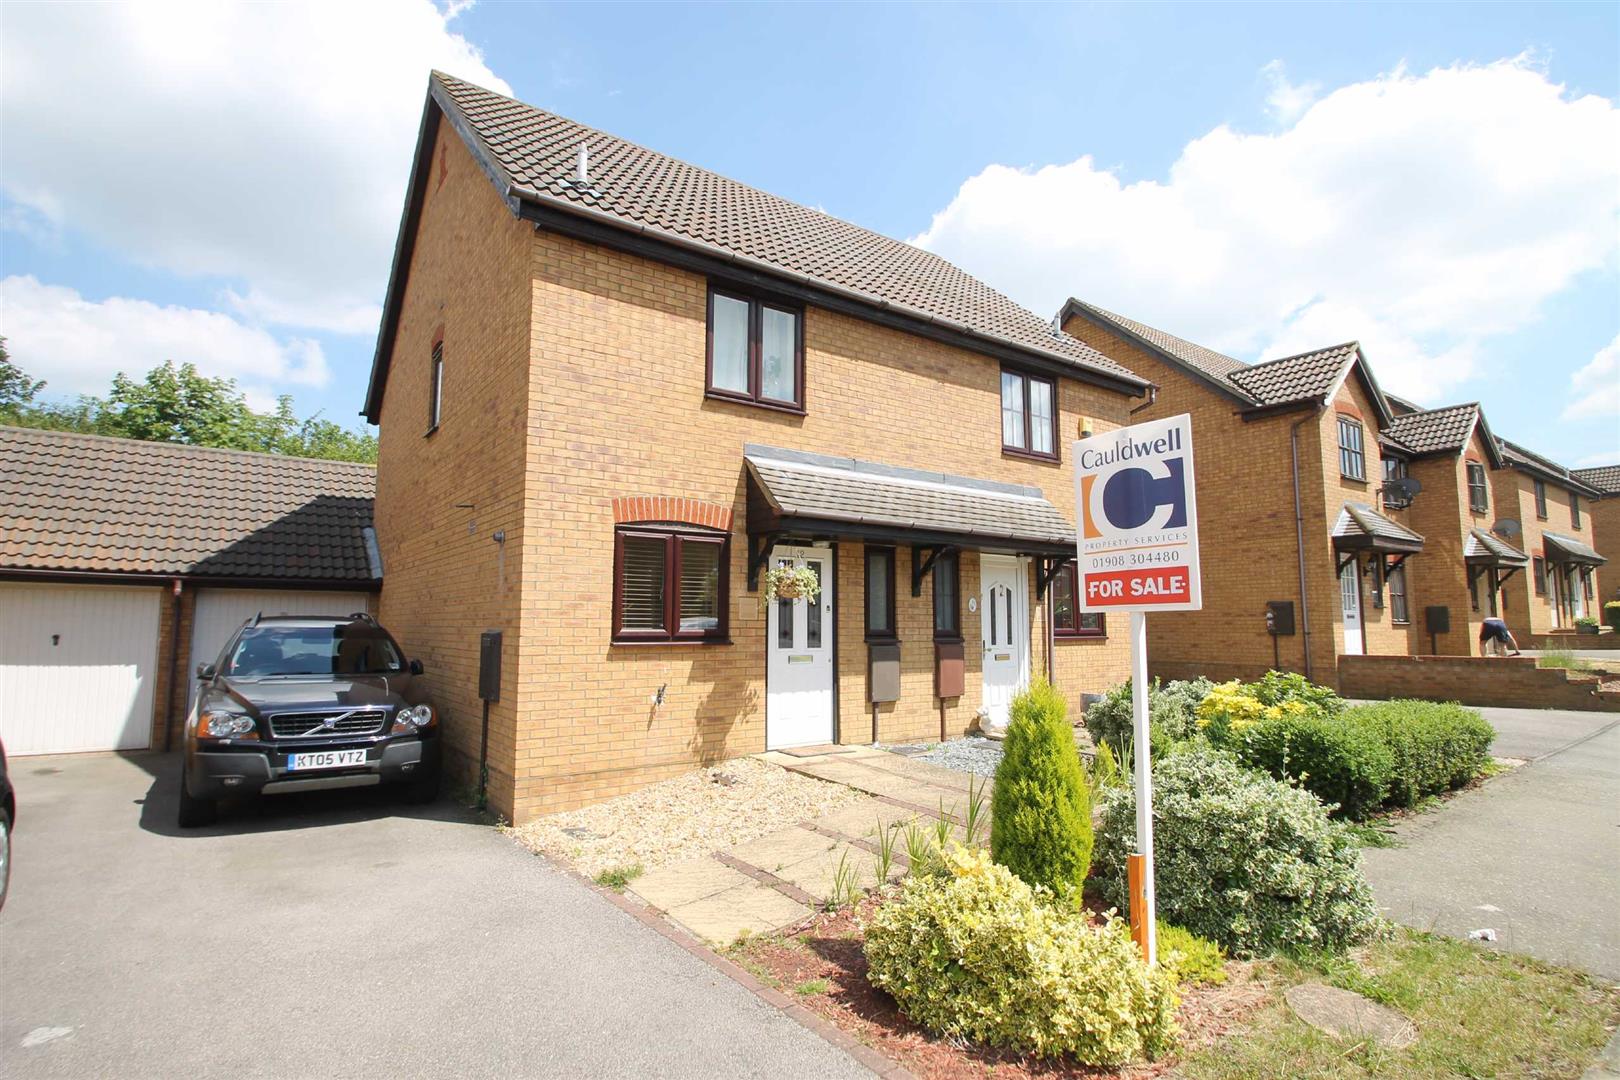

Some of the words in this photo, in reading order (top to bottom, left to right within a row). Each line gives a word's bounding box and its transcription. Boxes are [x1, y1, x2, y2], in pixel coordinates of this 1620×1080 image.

[1081, 428, 1181, 469] Cauldwell
[1085, 539, 1129, 550] PROPERTY
[1135, 532, 1188, 545] SERVICES
[1092, 555, 1125, 569] 01908
[1130, 551, 1179, 565] 304480
[1089, 580, 1123, 598] FOR
[1130, 576, 1185, 597] SALE
[297, 753, 334, 767] KT05
[338, 751, 363, 764] VTZ
